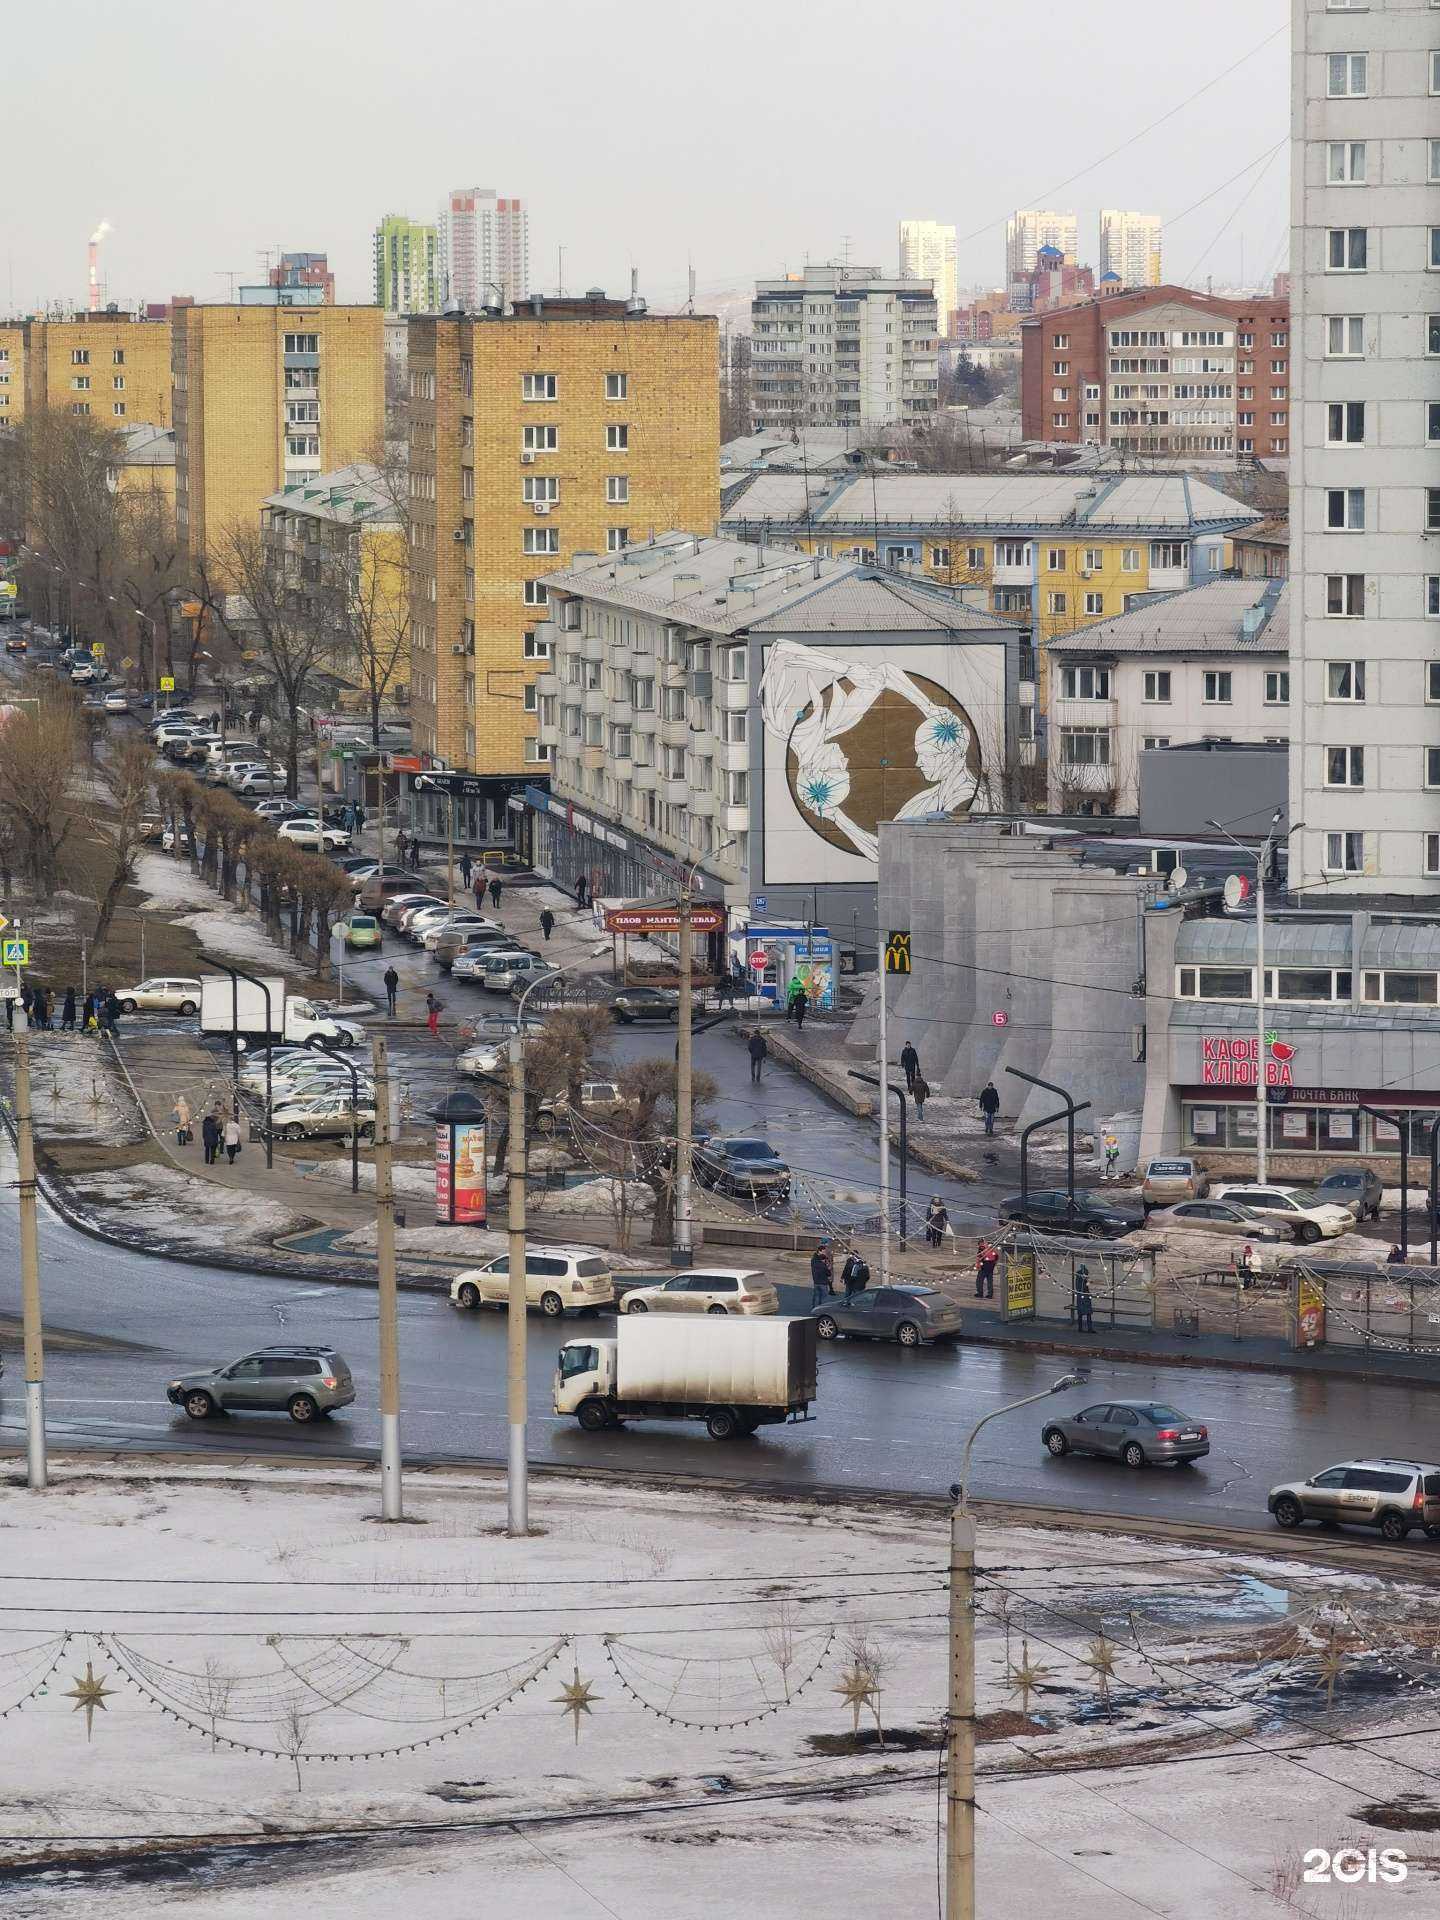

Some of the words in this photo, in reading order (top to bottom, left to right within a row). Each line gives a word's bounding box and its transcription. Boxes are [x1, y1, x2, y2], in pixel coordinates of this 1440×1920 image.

[1203, 1037, 1258, 1060] КАФЕ
[1292, 1089, 1326, 1099] ПОЧТА
[1330, 1090, 1359, 1101] БАНК
